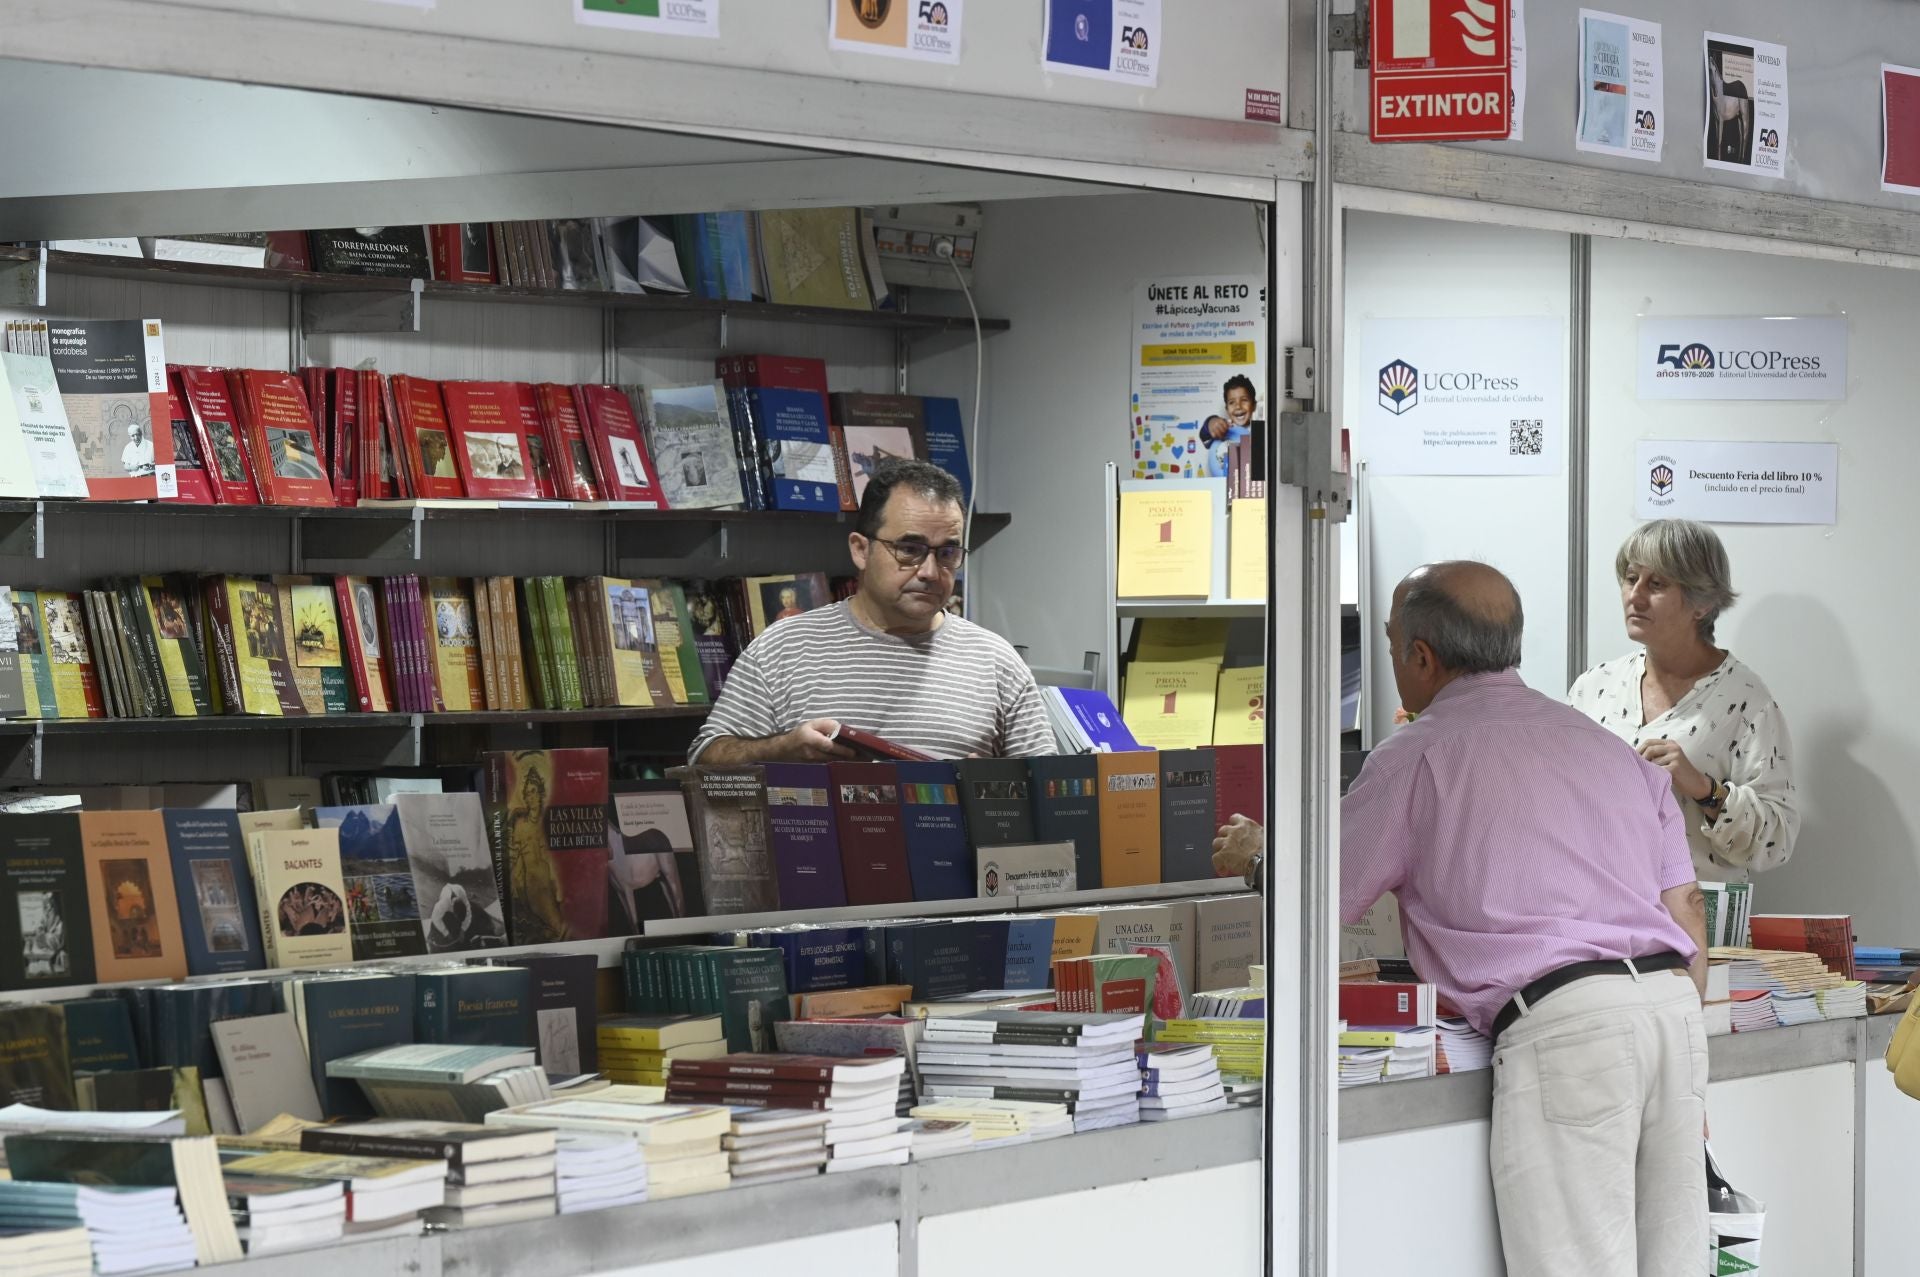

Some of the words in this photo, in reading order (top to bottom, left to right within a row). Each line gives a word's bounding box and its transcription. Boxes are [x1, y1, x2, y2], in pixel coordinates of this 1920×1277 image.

[1632, 32, 1656, 44] NOVEDAD
[1380, 92, 1500, 118] EXTINTOR
[331, 240, 408, 254] TORREPAREDONES
[1148, 284, 1188, 300] ÚNETE
[1193, 286, 1209, 300] AL
[1214, 284, 1248, 299] RETO
[1156, 303, 1240, 316] #LápicesyVacunas
[52, 328, 86, 336] monografías
[54, 348, 88, 356] cordobesa
[1657, 343, 1714, 369] 50
[1717, 351, 1820, 370] UCOPress
[1656, 369, 1680, 378] años
[1424, 372, 1519, 390] UCOPress
[1424, 394, 1454, 403] Editorial
[1456, 394, 1500, 403] Universidad
[1512, 394, 1544, 402] Córdoba
[1688, 470, 1734, 480] Descuento
[1736, 470, 1759, 480] Feria
[1760, 470, 1774, 480] del
[1776, 472, 1798, 482] libro
[1800, 472, 1812, 481] 10
[1813, 473, 1822, 482] %
[1704, 484, 1737, 492] (incluido
[1759, 486, 1782, 494] precio
[1784, 485, 1804, 494] final)
[1160, 690, 1176, 714] 1
[550, 808, 568, 821] LAS
[570, 807, 604, 820] VILLAS
[550, 821, 604, 834] ROMANAS
[550, 837, 560, 848] DE
[564, 836, 573, 846] LA
[284, 858, 322, 870] BACANTES
[1116, 925, 1132, 934] UNA
[1134, 924, 1154, 934] CASA
